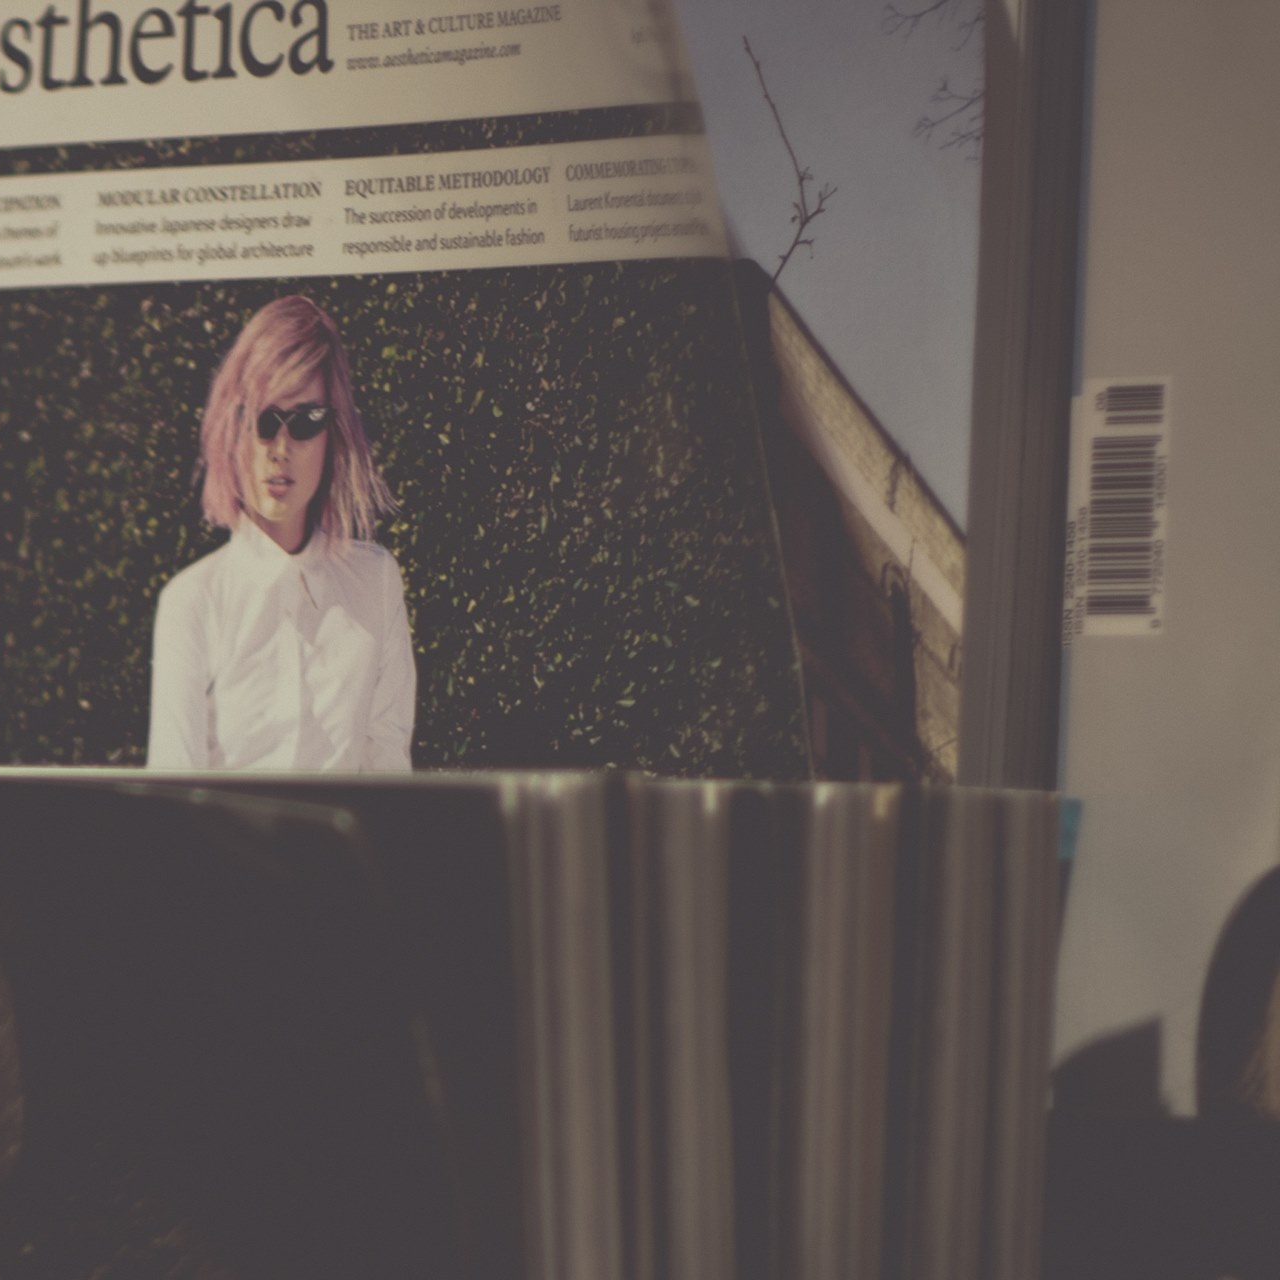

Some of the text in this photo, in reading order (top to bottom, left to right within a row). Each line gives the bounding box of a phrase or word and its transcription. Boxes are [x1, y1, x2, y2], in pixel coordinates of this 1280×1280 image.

[346, 4, 561, 41] THE ART & CULTURE MAGAZINE
[346, 41, 521, 70] www.aestheticamagazine.com
[344, 166, 552, 198] EQUITABLE METHODOLOGY
[565, 158, 666, 182] COMMEMORATING
[96, 181, 323, 207] MODULAR CONSTELLATION
[567, 193, 603, 212] Laurent
[95, 210, 312, 236] Innovative Japanese designers draw
[344, 198, 538, 225] The succession of developments in
[342, 227, 546, 258] responsible and sustainable fashion
[568, 223, 603, 243] futurist
[604, 220, 639, 243] housing
[111, 245, 174, 267] blueprints
[176, 242, 194, 261] for
[196, 241, 238, 266] global
[240, 240, 315, 261] architecture
[1063, 520, 1076, 647] ISSN 2240-1458
[1074, 596, 1085, 635] ISSN
